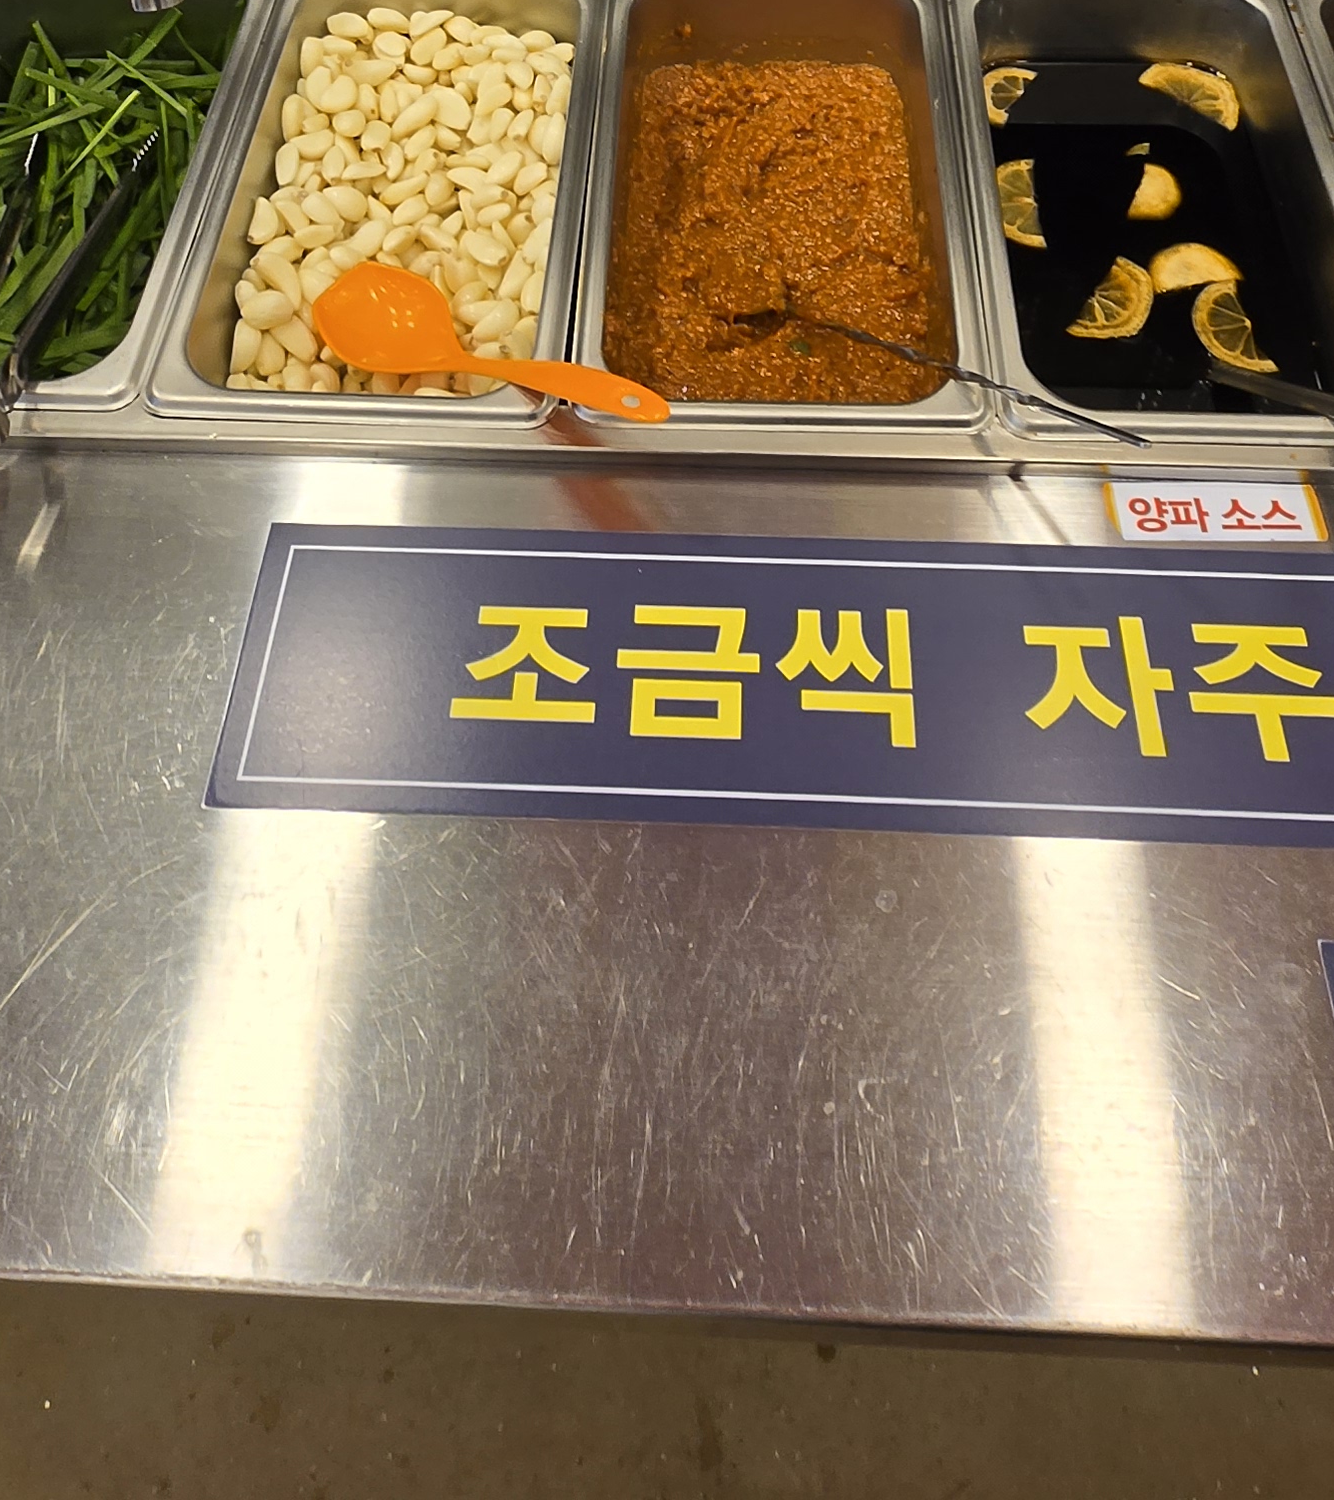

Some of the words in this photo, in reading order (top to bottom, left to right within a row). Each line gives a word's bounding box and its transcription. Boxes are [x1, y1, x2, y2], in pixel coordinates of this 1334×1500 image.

[1127, 497, 1210, 533] 양파
[1221, 498, 1303, 531] 소스
[450, 604, 917, 749] 조금씩
